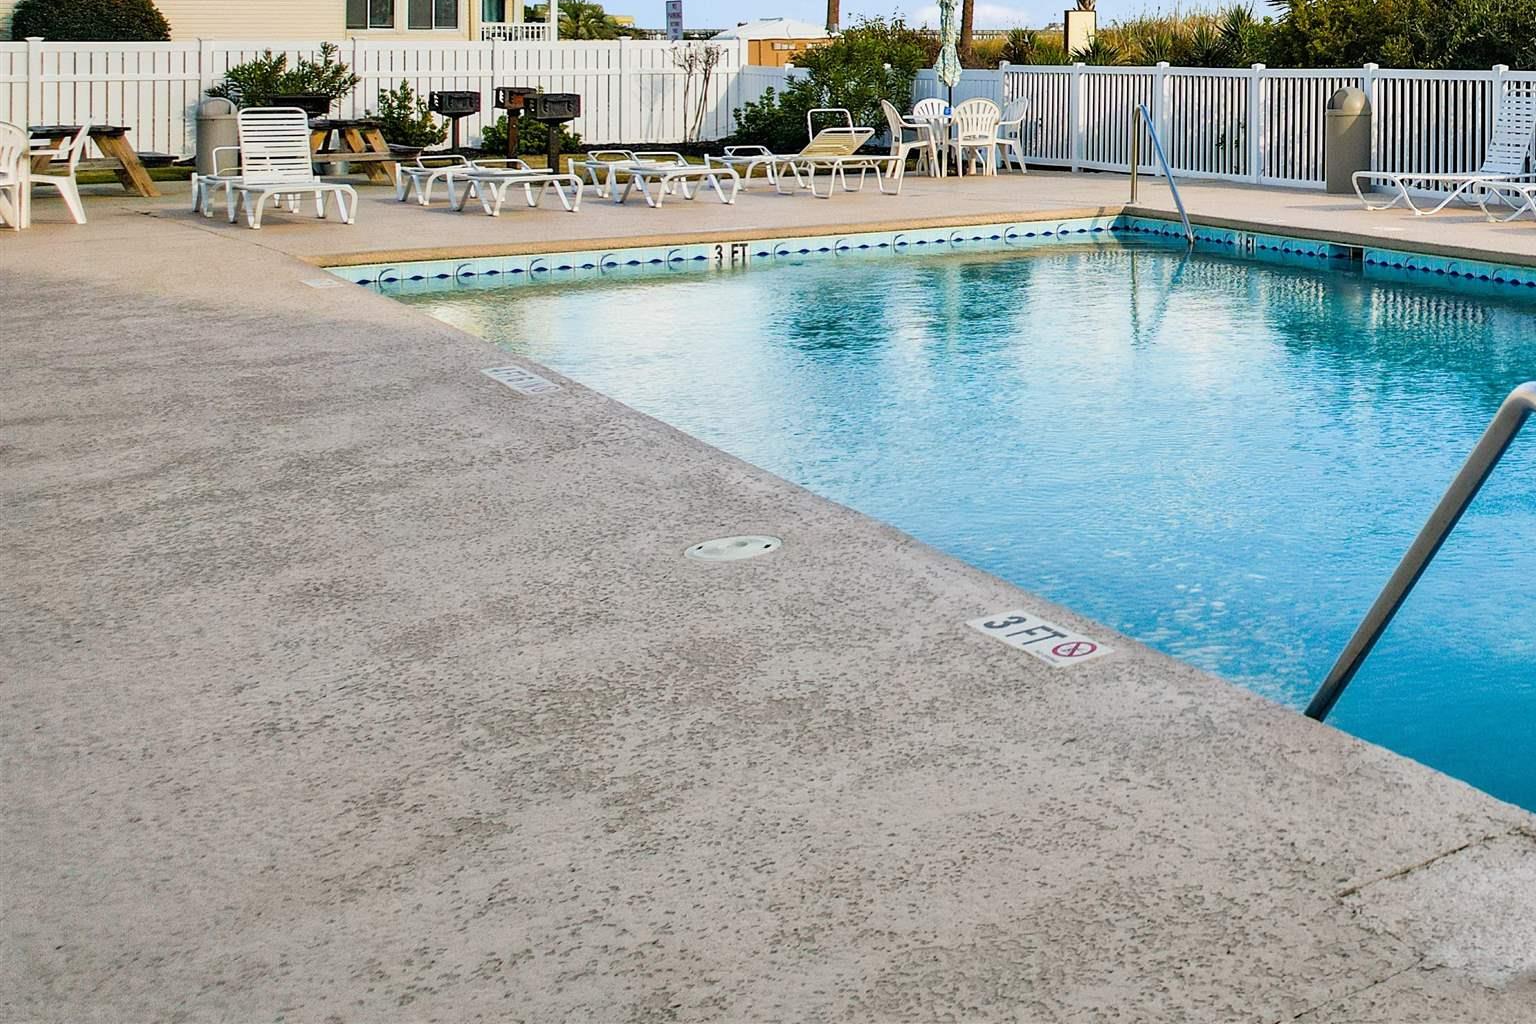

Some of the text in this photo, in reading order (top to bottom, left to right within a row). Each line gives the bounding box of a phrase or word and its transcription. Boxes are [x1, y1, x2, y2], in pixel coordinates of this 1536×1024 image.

[715, 243, 748, 259] 3 FT
[983, 616, 1068, 645] 3 FT
